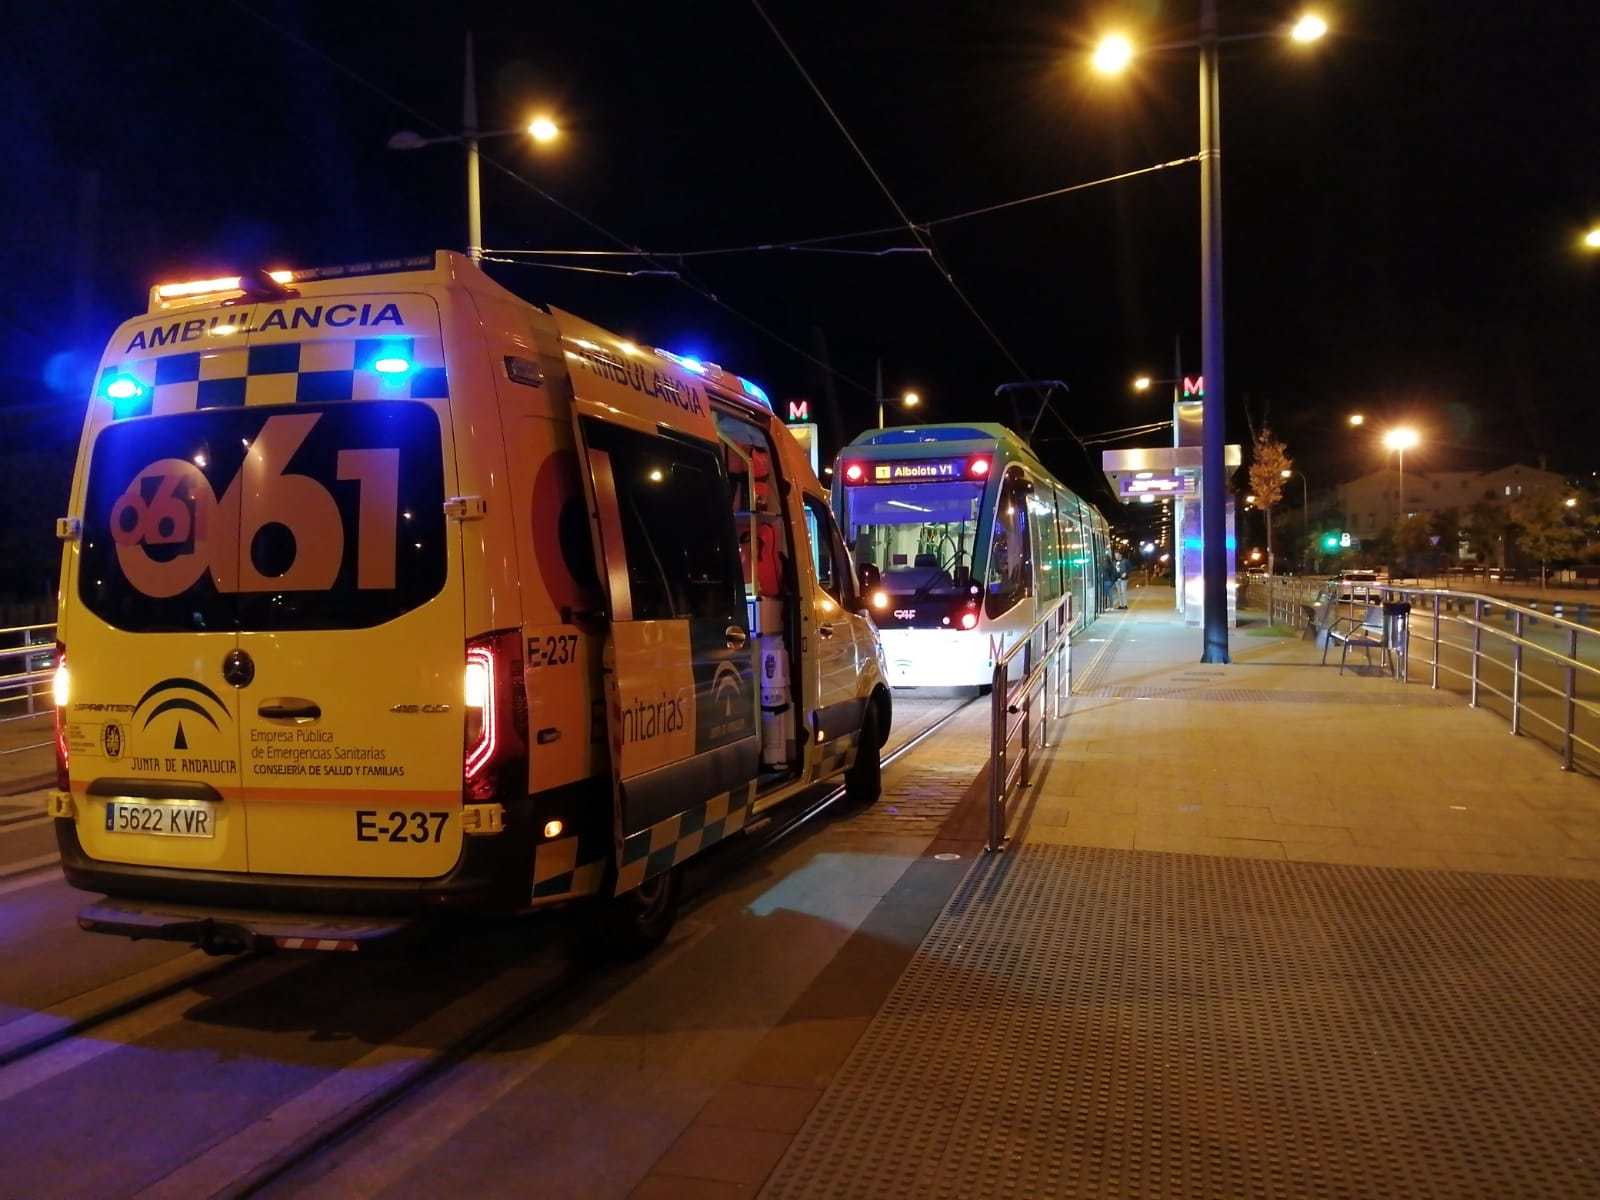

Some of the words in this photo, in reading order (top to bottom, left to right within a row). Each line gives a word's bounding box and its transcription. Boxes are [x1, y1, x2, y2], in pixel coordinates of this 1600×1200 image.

[126, 302, 404, 353] AMBULANCIA
[1183, 376, 1204, 397] M
[789, 401, 809, 420] M
[895, 466, 937, 477] Albolote
[939, 465, 952, 475] V1
[111, 412, 401, 599] 061
[527, 635, 578, 667] E-237
[251, 729, 293, 745] Empresa
[297, 729, 333, 743] Pública
[252, 746, 264, 758] de
[267, 746, 332, 762] Emergencias
[335, 746, 386, 760] Sanitarias
[131, 758, 160, 771] JUNTA
[165, 759, 177, 772] DE
[182, 759, 237, 774] ANDALUCIA
[309, 765, 321, 775] DE
[324, 765, 353, 776] SALUD
[362, 766, 405, 777] FAMILIAS
[118, 806, 163, 832] 5622
[169, 808, 209, 834] KVR
[356, 810, 449, 843] E-237
